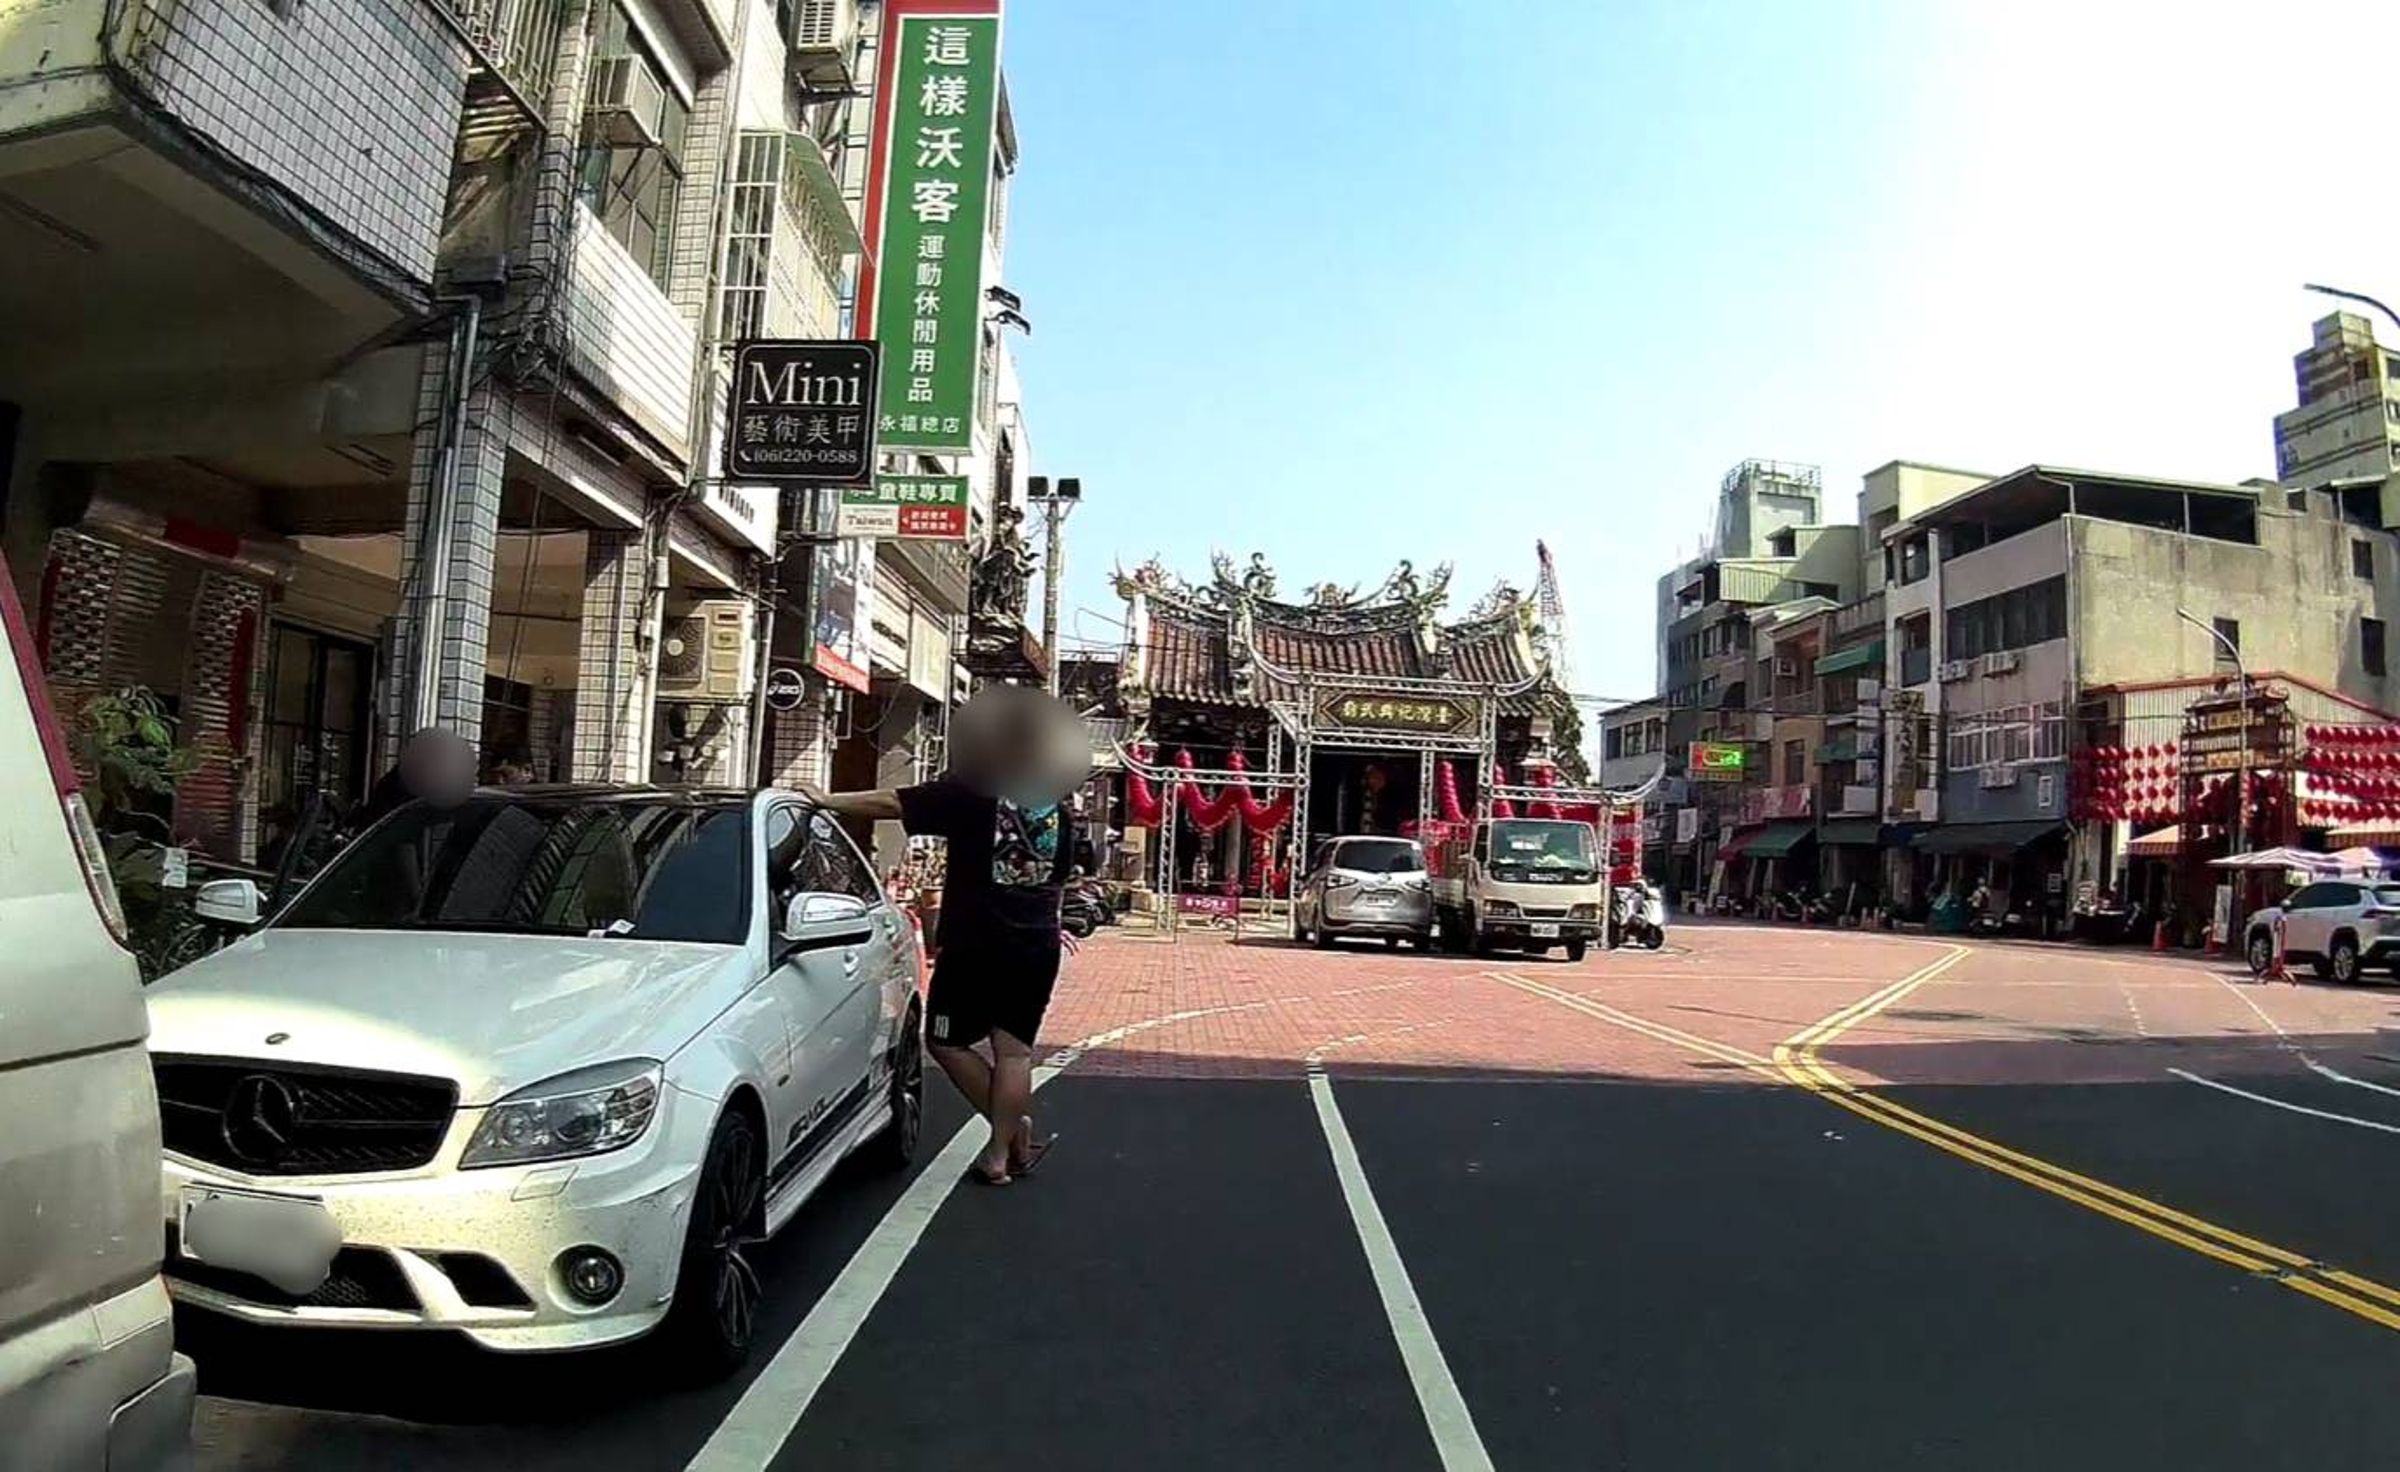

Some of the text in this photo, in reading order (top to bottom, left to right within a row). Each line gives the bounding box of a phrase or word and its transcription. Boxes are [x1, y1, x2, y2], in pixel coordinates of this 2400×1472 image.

[911, 26, 972, 223] 這樣沃客
[907, 234, 945, 402] 運動休閒用品
[743, 414, 860, 444] 藝術美甲
[745, 362, 862, 406] Mini
